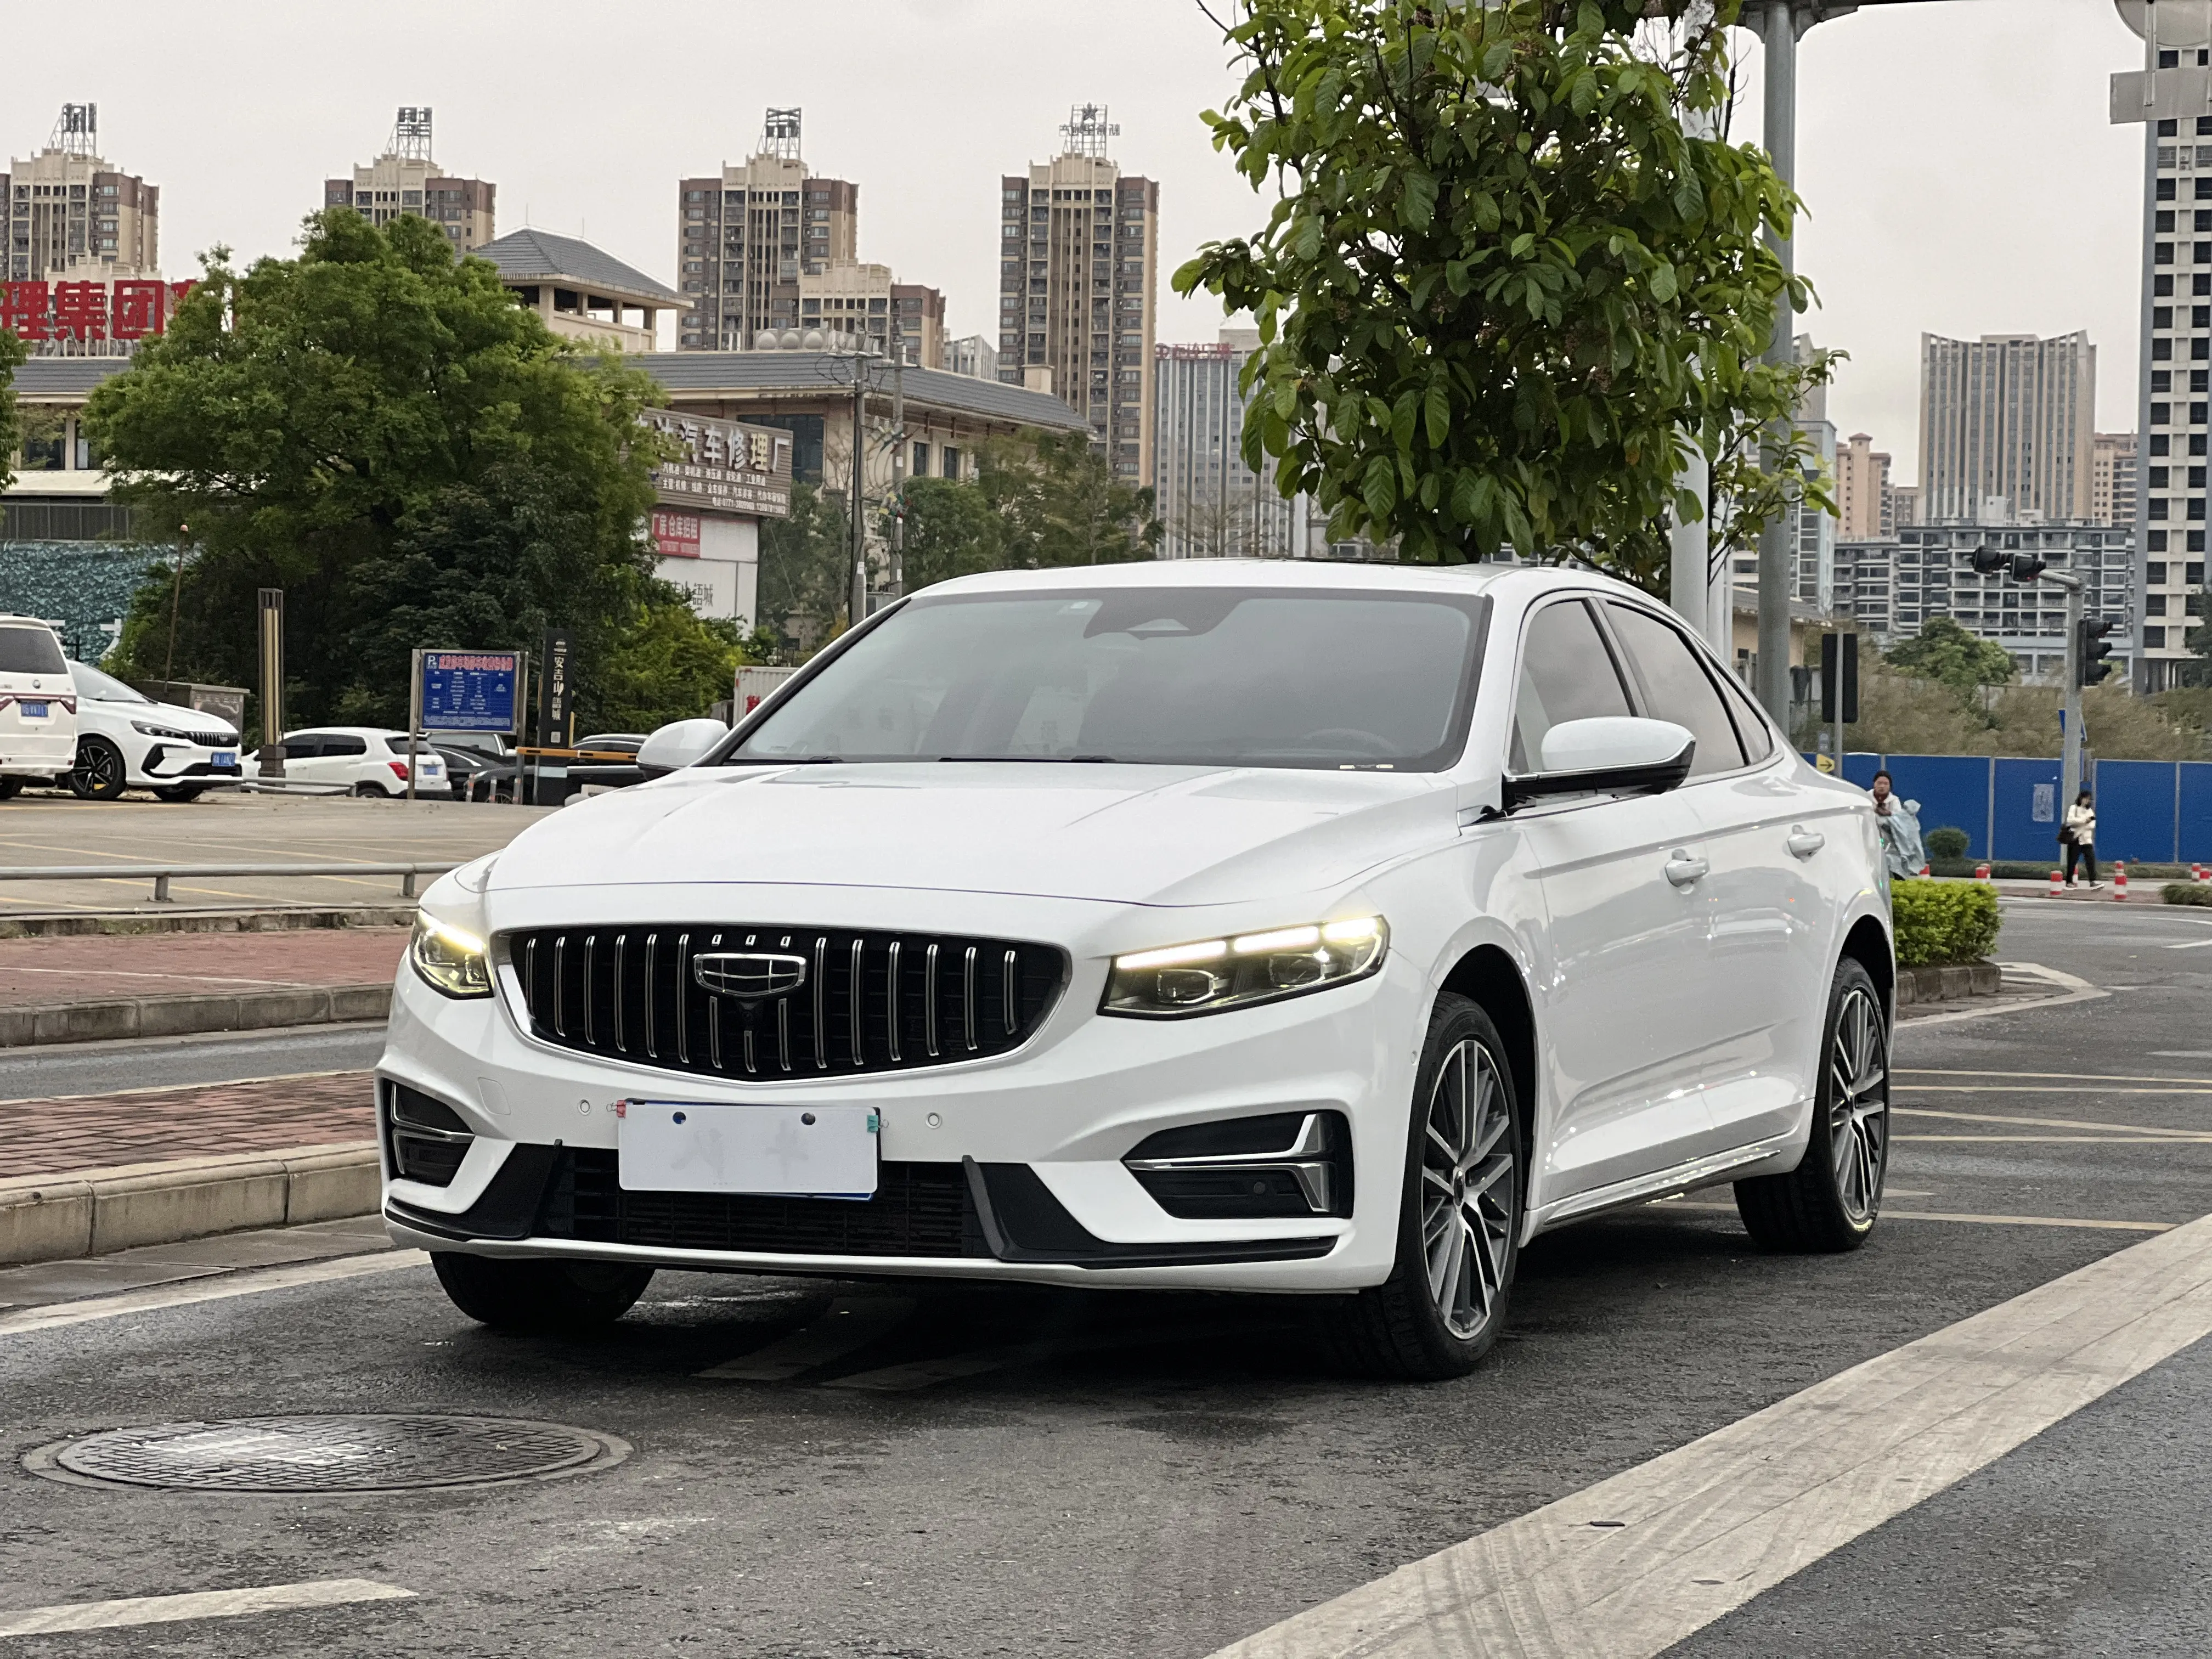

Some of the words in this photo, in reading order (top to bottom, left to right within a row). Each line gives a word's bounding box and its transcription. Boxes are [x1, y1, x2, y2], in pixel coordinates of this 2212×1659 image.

[0, 279, 198, 340] 理集团
[632, 415, 790, 473] 汽车修理厂
